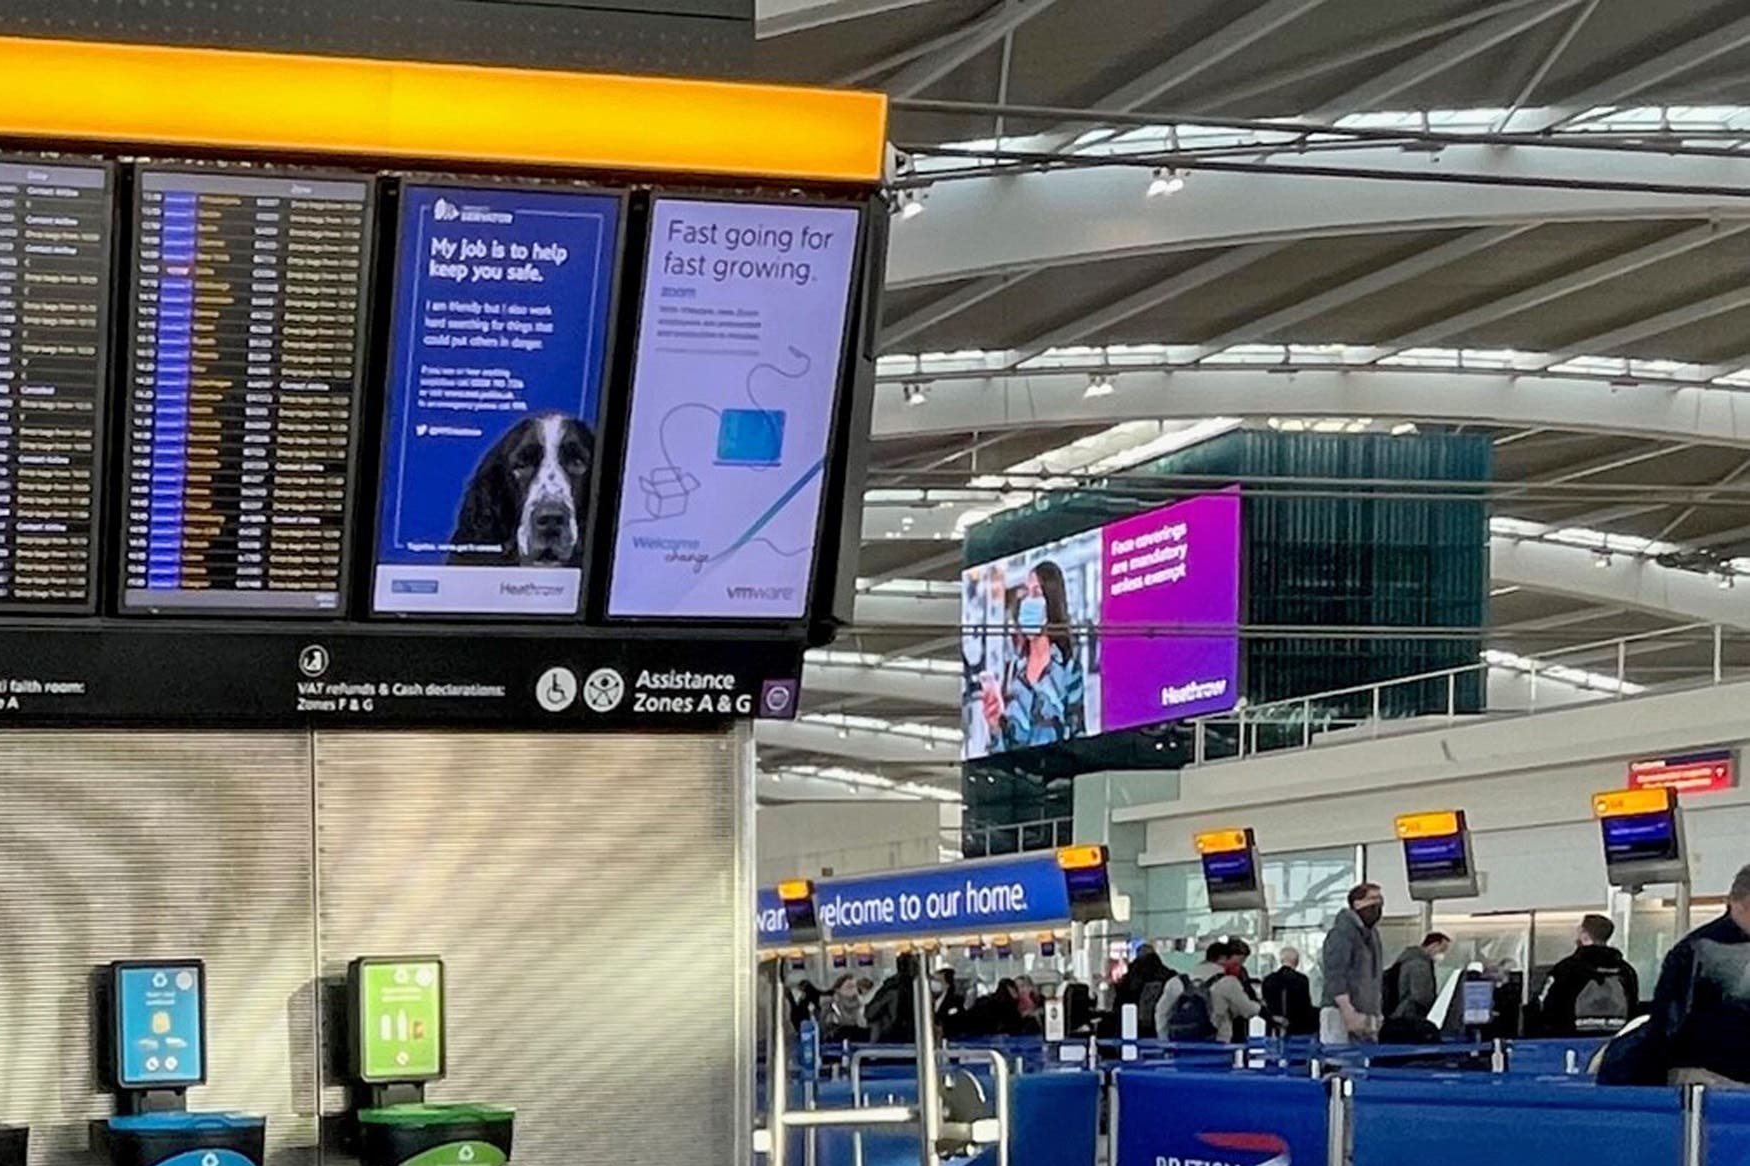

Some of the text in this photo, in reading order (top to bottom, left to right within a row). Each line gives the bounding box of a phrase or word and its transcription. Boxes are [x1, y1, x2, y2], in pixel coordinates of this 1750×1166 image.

[667, 218, 835, 253] Fast going for
[430, 236, 568, 266] My job is to help
[428, 259, 544, 282] keep you safe.
[662, 251, 819, 287] fast growing.
[631, 535, 702, 551] Welcome
[664, 550, 710, 575] change
[499, 580, 565, 597] Heathrow
[725, 586, 796, 601] vmware
[9, 679, 42, 694] faith
[44, 681, 85, 694] room:
[295, 682, 325, 696] VAT
[325, 682, 376, 697] refunds
[378, 682, 390, 697] &
[391, 682, 423, 697] Cash
[635, 668, 736, 691] Assistance
[6, 695, 20, 710] A
[633, 692, 753, 714] Zones A & G
[1160, 678, 1228, 707] Heathrow
[296, 698, 336, 712] Zones
[348, 698, 360, 712] &
[362, 698, 374, 712] G
[899, 892, 919, 922] to
[926, 890, 961, 920] our
[965, 879, 1029, 914] home.
